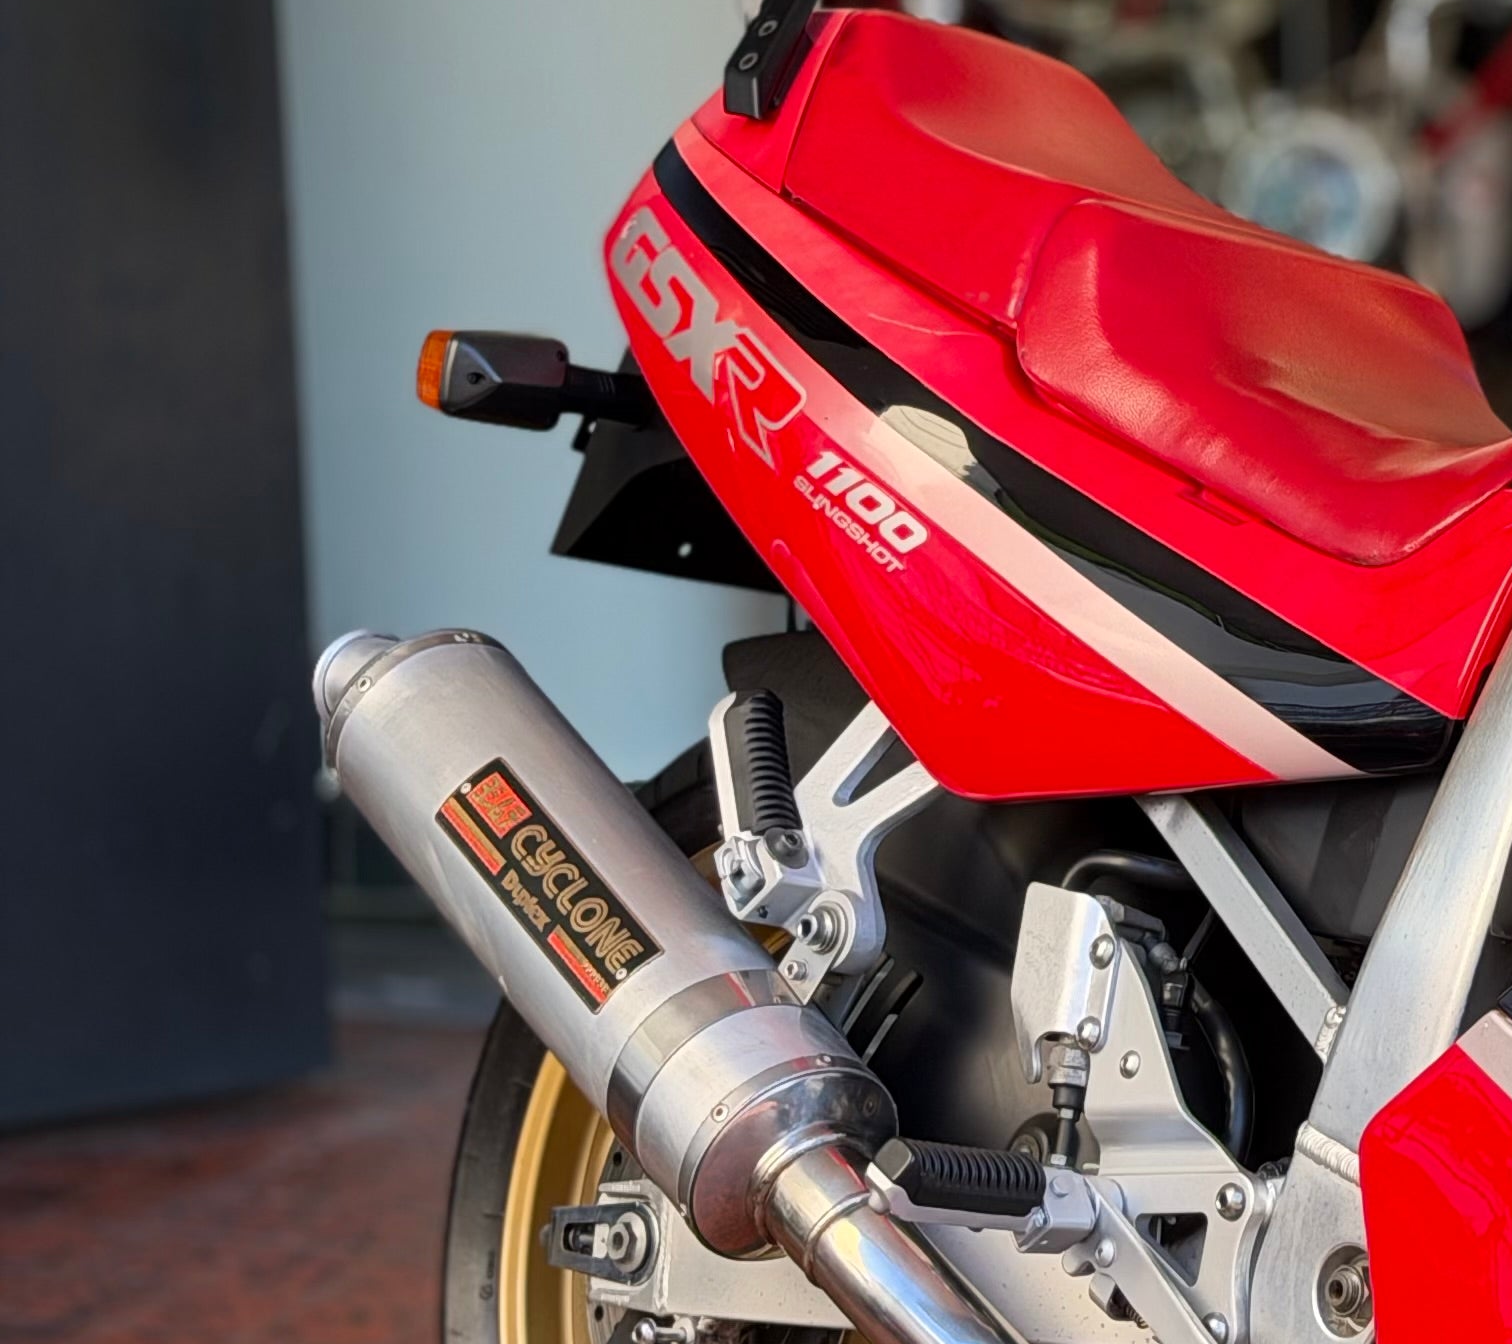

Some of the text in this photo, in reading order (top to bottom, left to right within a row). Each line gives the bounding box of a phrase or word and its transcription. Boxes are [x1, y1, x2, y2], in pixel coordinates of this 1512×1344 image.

[793, 475, 905, 573] SLINGSHOT
[805, 450, 928, 554] 1100
[511, 824, 644, 974] CYCLONE
